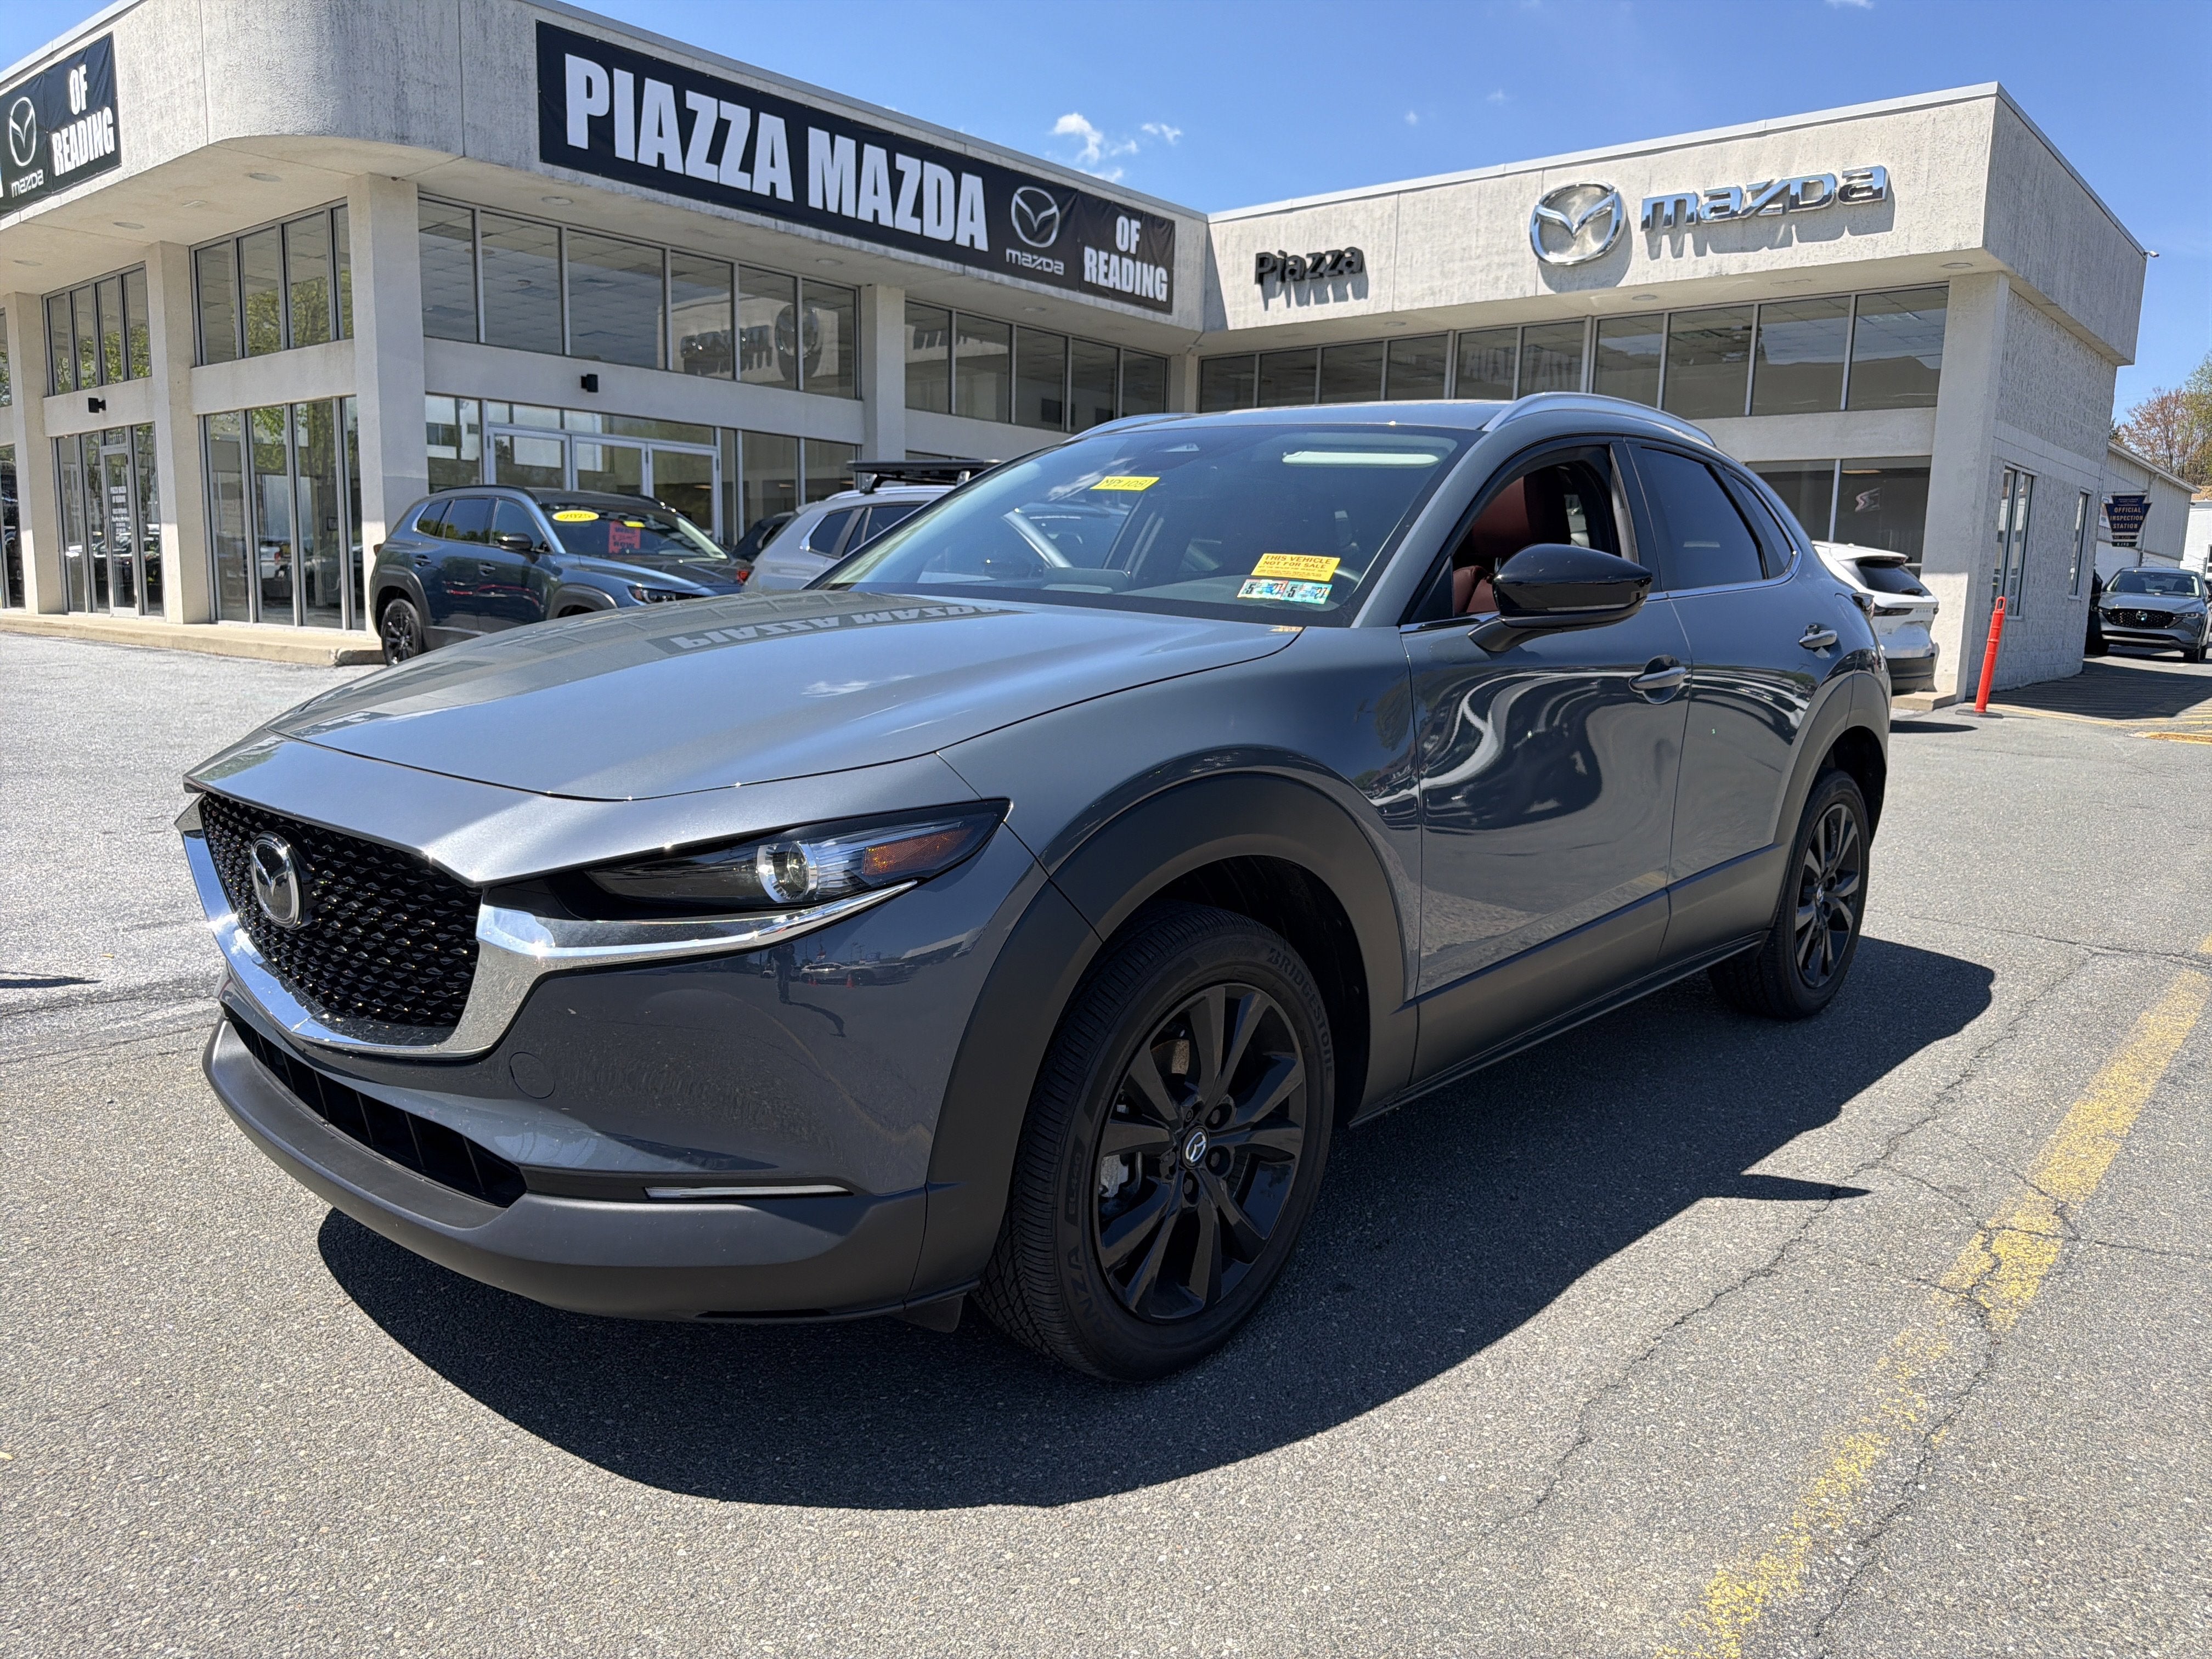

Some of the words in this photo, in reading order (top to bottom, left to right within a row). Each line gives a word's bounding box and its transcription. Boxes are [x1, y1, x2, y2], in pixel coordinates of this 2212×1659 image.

[69, 64, 88, 115] OF
[52, 106, 115, 177] READING
[565, 53, 794, 203] PIAZZA
[807, 126, 989, 252] MAZDA
[1115, 215, 1141, 255] OF
[1084, 246, 1168, 302] READING
[1254, 246, 1364, 285] Piazza
[1290, 556, 1333, 565] VEHICLE
